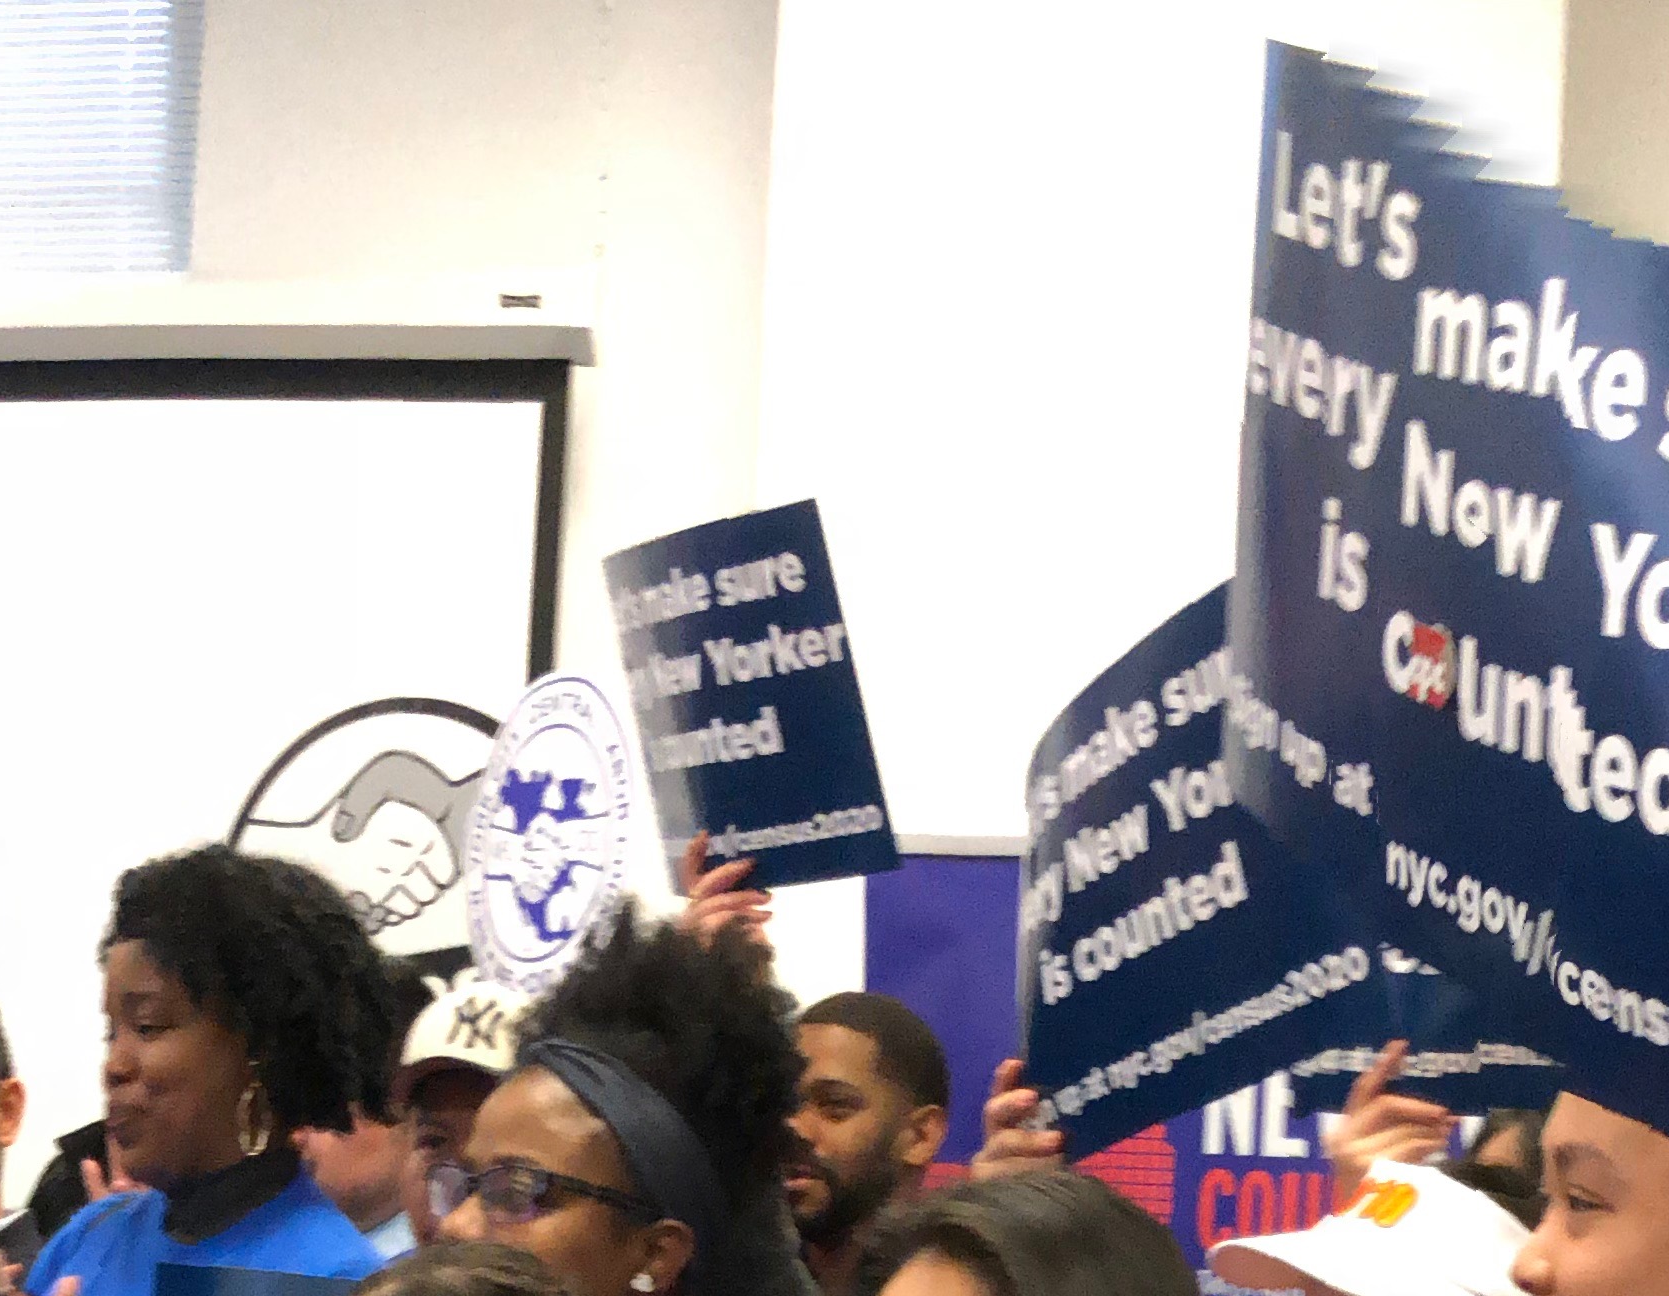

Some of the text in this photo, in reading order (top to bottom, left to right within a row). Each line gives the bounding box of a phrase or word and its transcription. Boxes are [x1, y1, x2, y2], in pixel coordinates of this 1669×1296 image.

[1271, 131, 1424, 279] Let's
[1414, 277, 1649, 441] make
[1318, 498, 1370, 612] is
[702, 622, 845, 686] Yorker
[1072, 839, 1250, 984] counted
